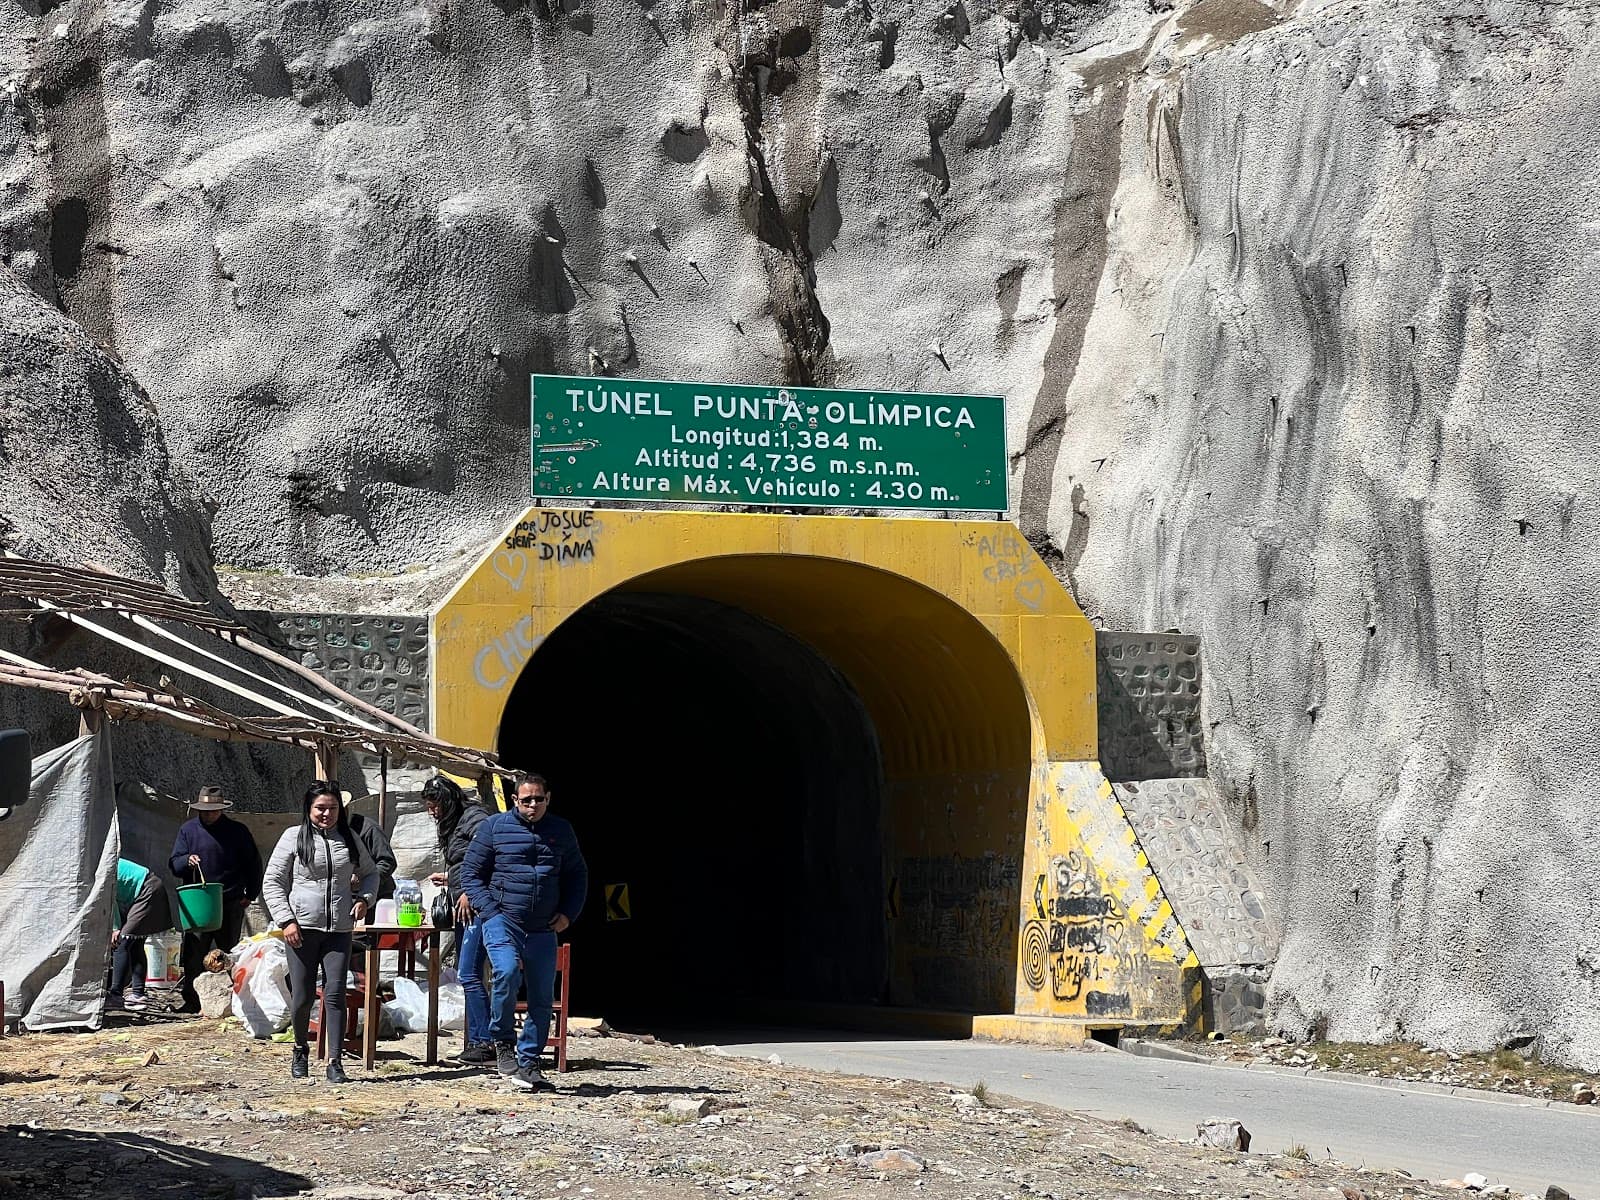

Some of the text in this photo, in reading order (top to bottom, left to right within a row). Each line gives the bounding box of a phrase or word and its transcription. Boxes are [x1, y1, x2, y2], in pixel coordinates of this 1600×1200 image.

[566, 384, 976, 429] TÚNEL PUNTA OLÍMPICA
[859, 436, 883, 450] m.
[635, 448, 719, 469] Altitud
[740, 453, 816, 474] 4,736
[829, 459, 920, 476] m.s.n.m.
[592, 471, 670, 492] Altura
[684, 473, 738, 495] Máx.
[745, 476, 841, 497] Vehículo
[866, 481, 923, 500] 4.30
[930, 485, 955, 501] m.
[539, 511, 594, 533] JOSUE
